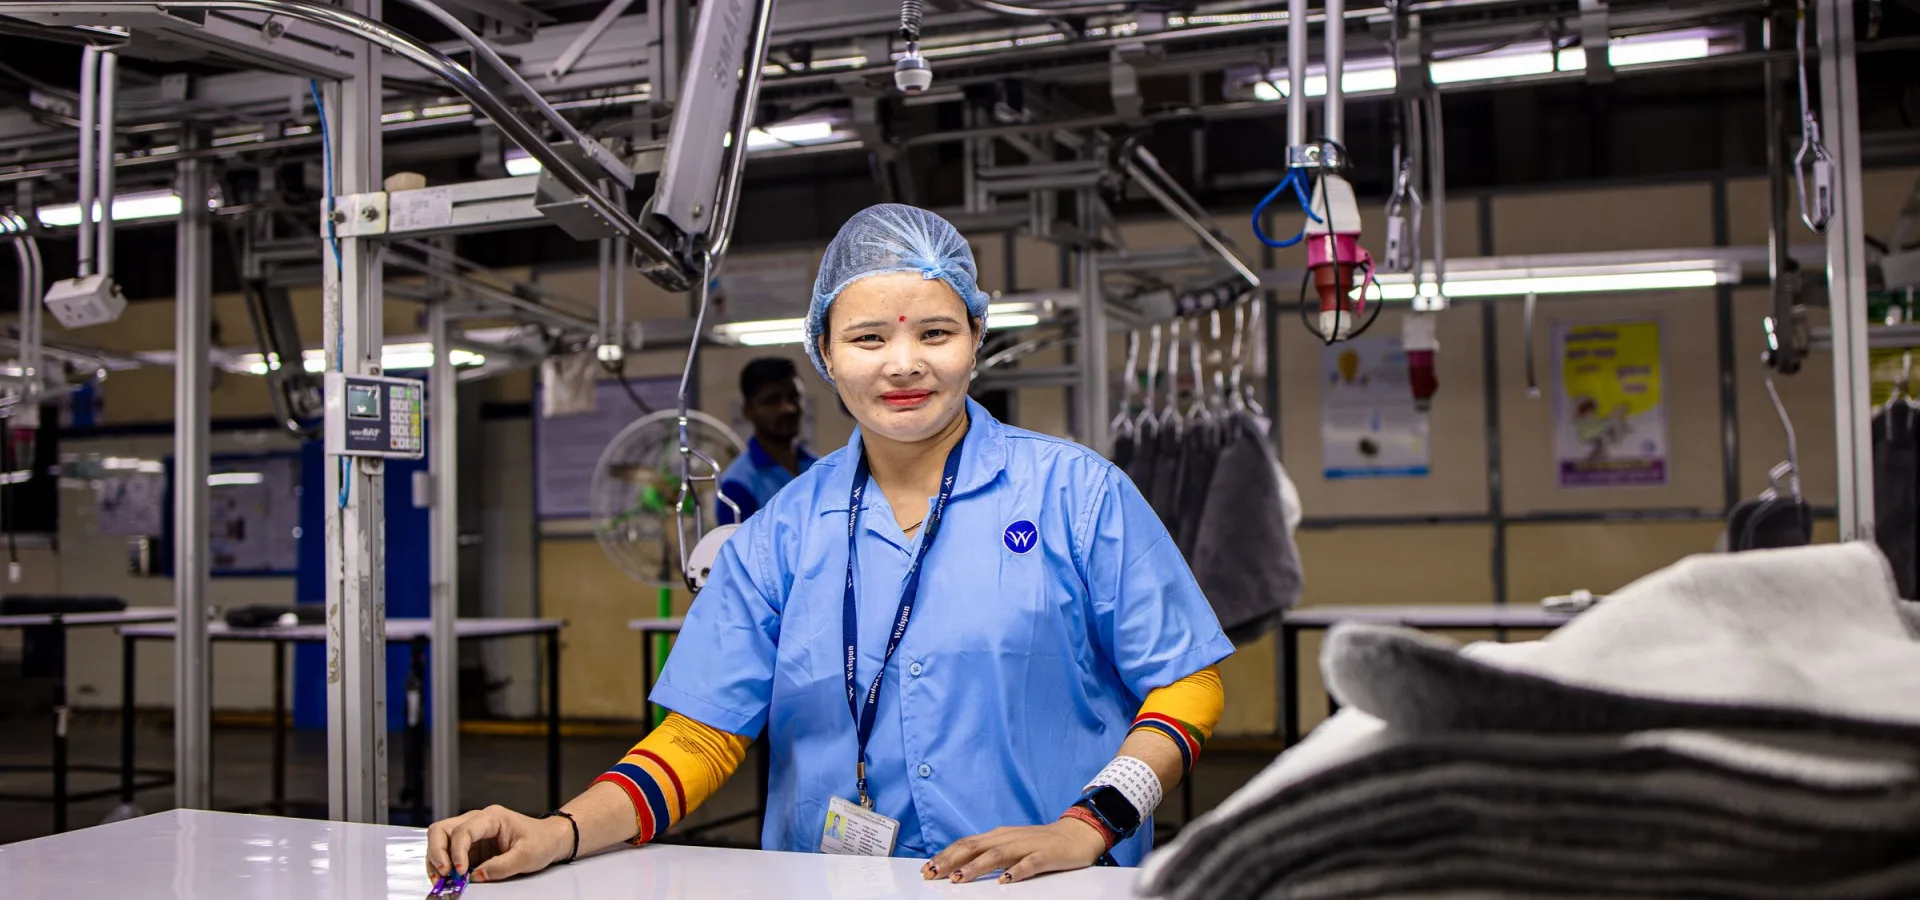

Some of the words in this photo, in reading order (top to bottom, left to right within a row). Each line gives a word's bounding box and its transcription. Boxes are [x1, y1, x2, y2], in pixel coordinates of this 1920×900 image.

[849, 504, 859, 537] Welspun
[893, 605, 911, 639] Welspun
[846, 645, 856, 681] Welspun
